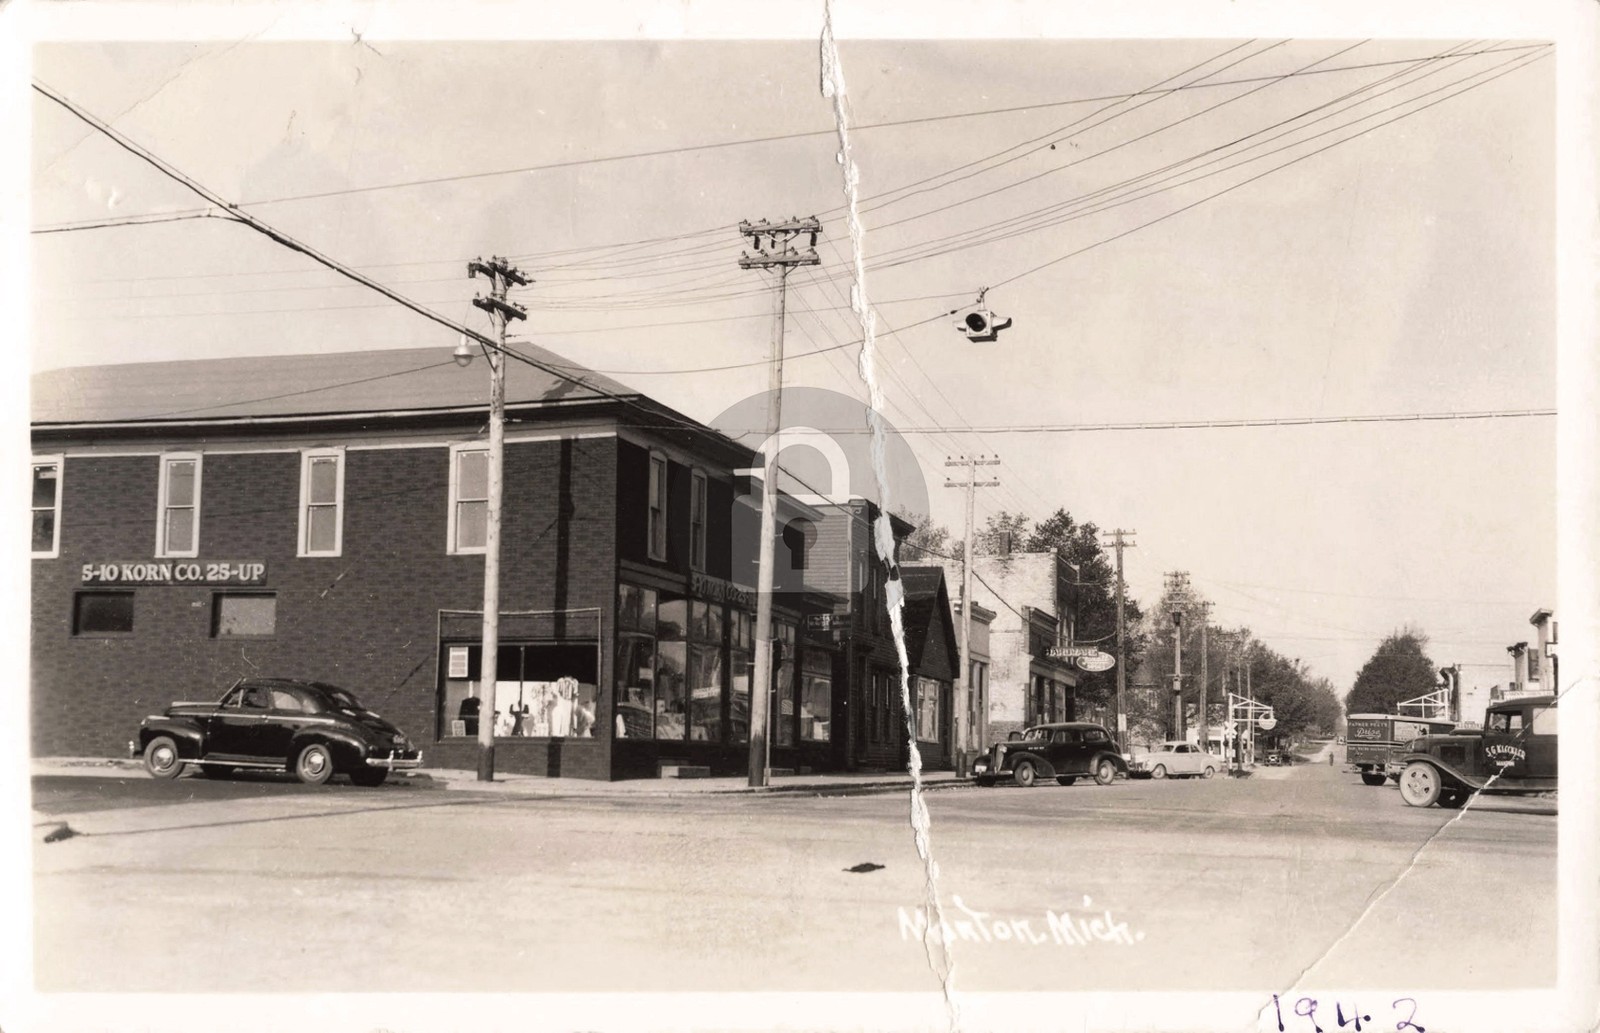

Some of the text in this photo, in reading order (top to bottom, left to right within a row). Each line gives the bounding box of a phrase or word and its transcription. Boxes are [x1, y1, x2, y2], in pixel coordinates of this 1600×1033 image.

[82, 563, 265, 581] 5-10 KORN CO. 25-UP
